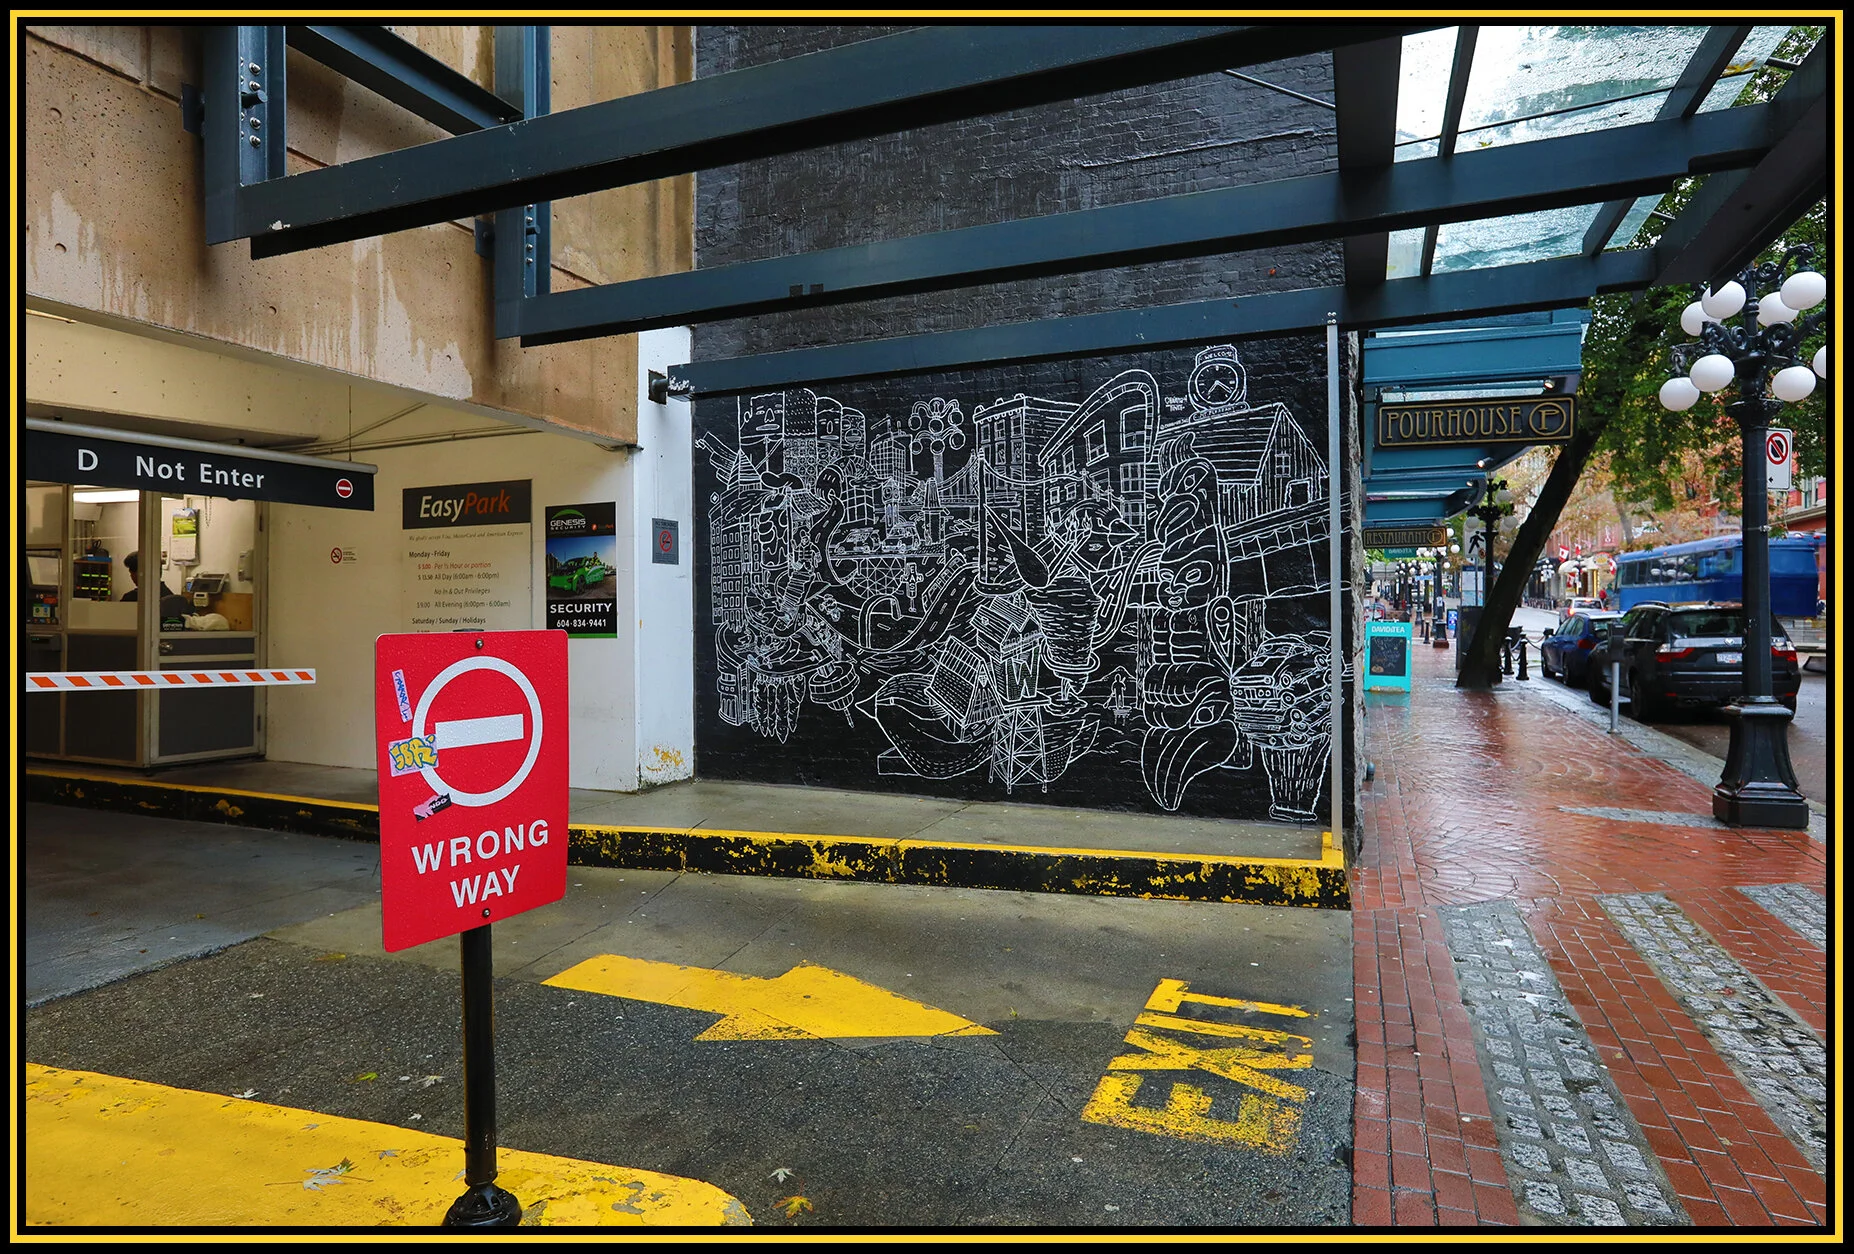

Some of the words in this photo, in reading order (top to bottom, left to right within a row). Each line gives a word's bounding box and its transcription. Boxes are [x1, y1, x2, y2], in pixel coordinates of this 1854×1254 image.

[1386, 406, 1522, 439] POURHOUSE
[136, 455, 185, 481] Not
[200, 463, 265, 488] Enter
[419, 488, 513, 523] EasyPark
[550, 518, 586, 528] GENESIS
[1366, 530, 1427, 545] RESTAURANT
[434, 550, 450, 558] Friday
[471, 562, 492, 570] portion
[442, 574, 452, 582] Day
[478, 572, 500, 580] 6:00pm)
[464, 587, 491, 596] Privileges
[442, 600, 462, 609] Evening
[464, 600, 486, 608] (6:00pm
[488, 600, 510, 608] 6:00am)
[550, 603, 612, 614] SECURITY
[412, 618, 435, 626] Saturday
[438, 618, 458, 626] Sunday
[462, 616, 486, 625] Holidays
[411, 819, 549, 875] WRONG
[450, 865, 521, 908] WAY
[1080, 977, 1318, 1157] EXIT
